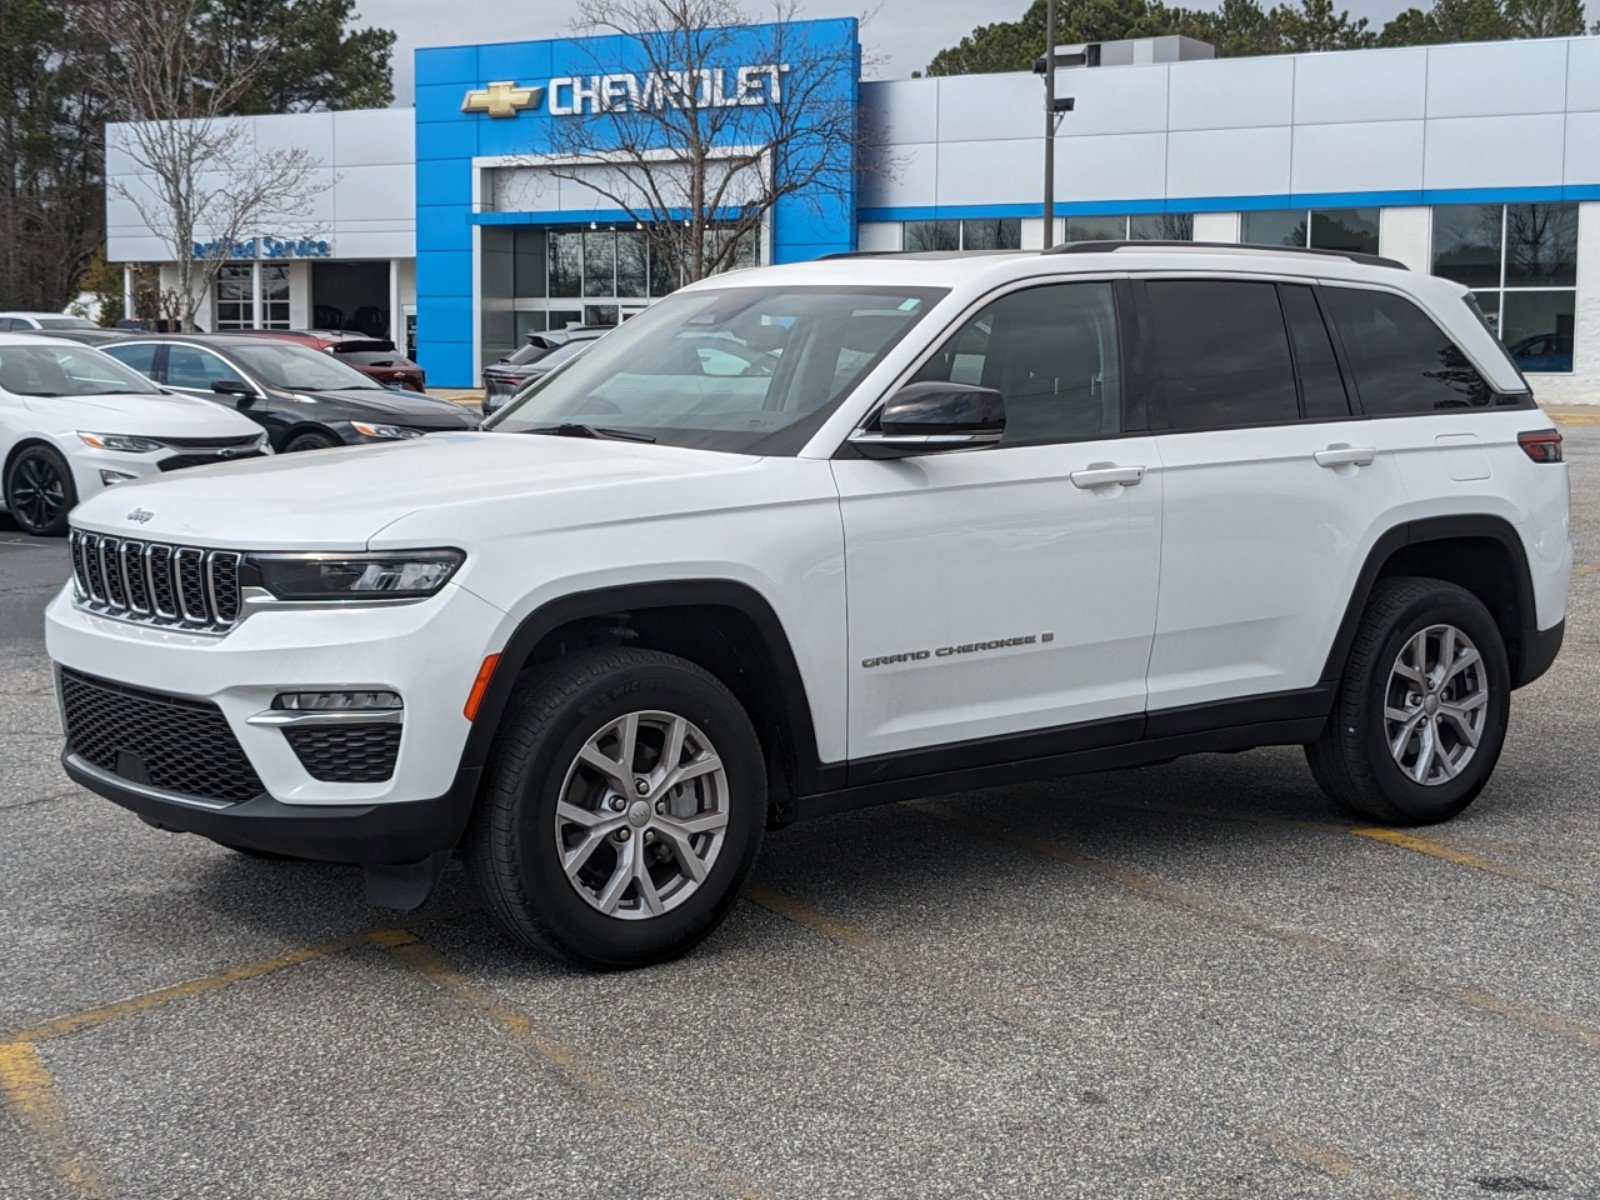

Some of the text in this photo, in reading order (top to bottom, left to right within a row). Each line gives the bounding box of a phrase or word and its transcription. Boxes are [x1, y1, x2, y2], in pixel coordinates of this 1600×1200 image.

[549, 64, 790, 116] CHEVROLET
[263, 235, 330, 257] Service
[127, 507, 154, 524] Jeep
[862, 635, 1037, 668] GRAND CHEROKEE
